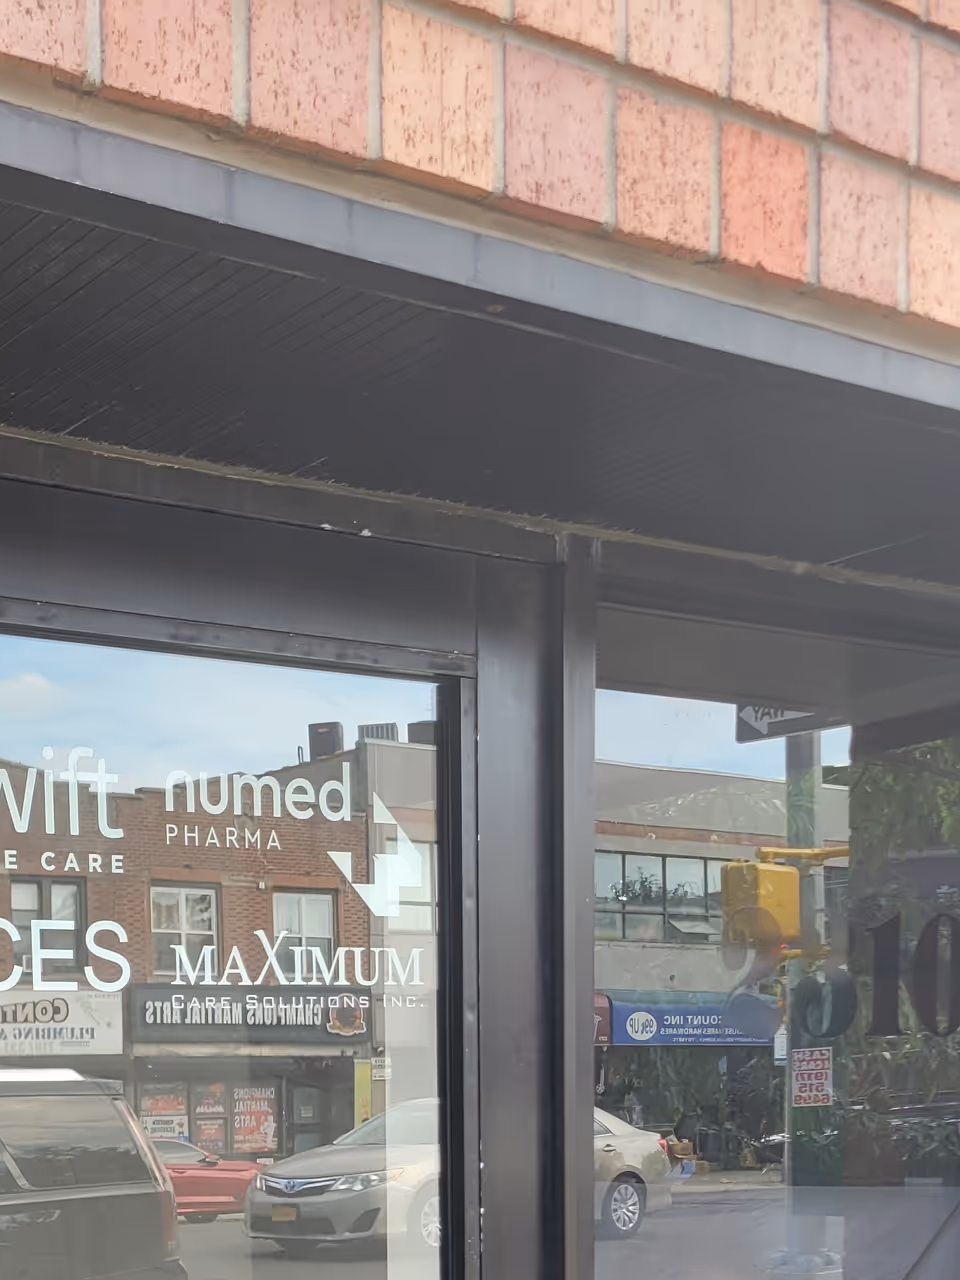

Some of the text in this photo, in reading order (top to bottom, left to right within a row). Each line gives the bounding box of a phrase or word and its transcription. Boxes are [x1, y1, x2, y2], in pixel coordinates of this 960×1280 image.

[165, 762, 352, 822] numed
[166, 824, 282, 851] PHARMA
[41, 852, 125, 874] CARE
[170, 929, 425, 986] MAXIMUM
[172, 993, 425, 1009] CARE SOLUTIONS INC.
